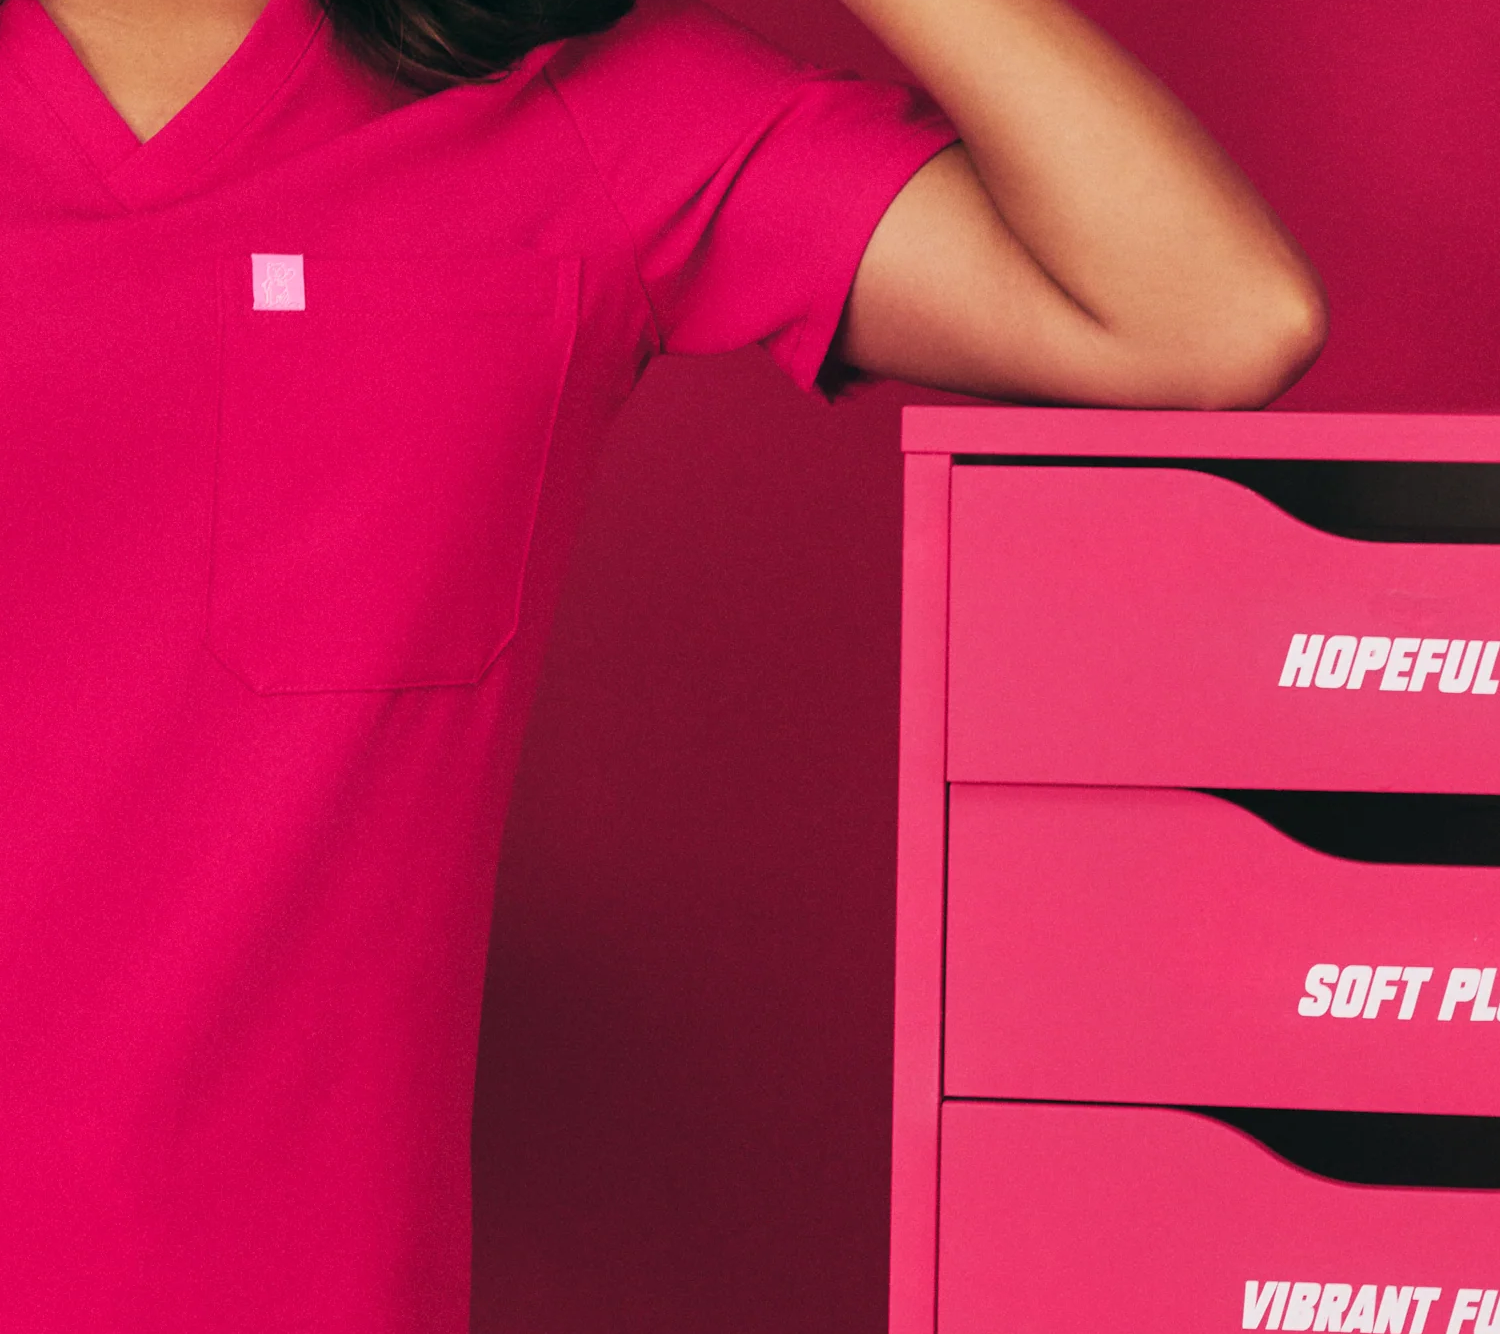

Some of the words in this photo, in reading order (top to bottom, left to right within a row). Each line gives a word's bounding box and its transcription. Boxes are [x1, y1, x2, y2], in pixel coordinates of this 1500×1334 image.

[1279, 634, 1500, 696] HOPEFUL
[1297, 964, 1435, 1022] SOFT
[1438, 968, 1500, 1023] PL
